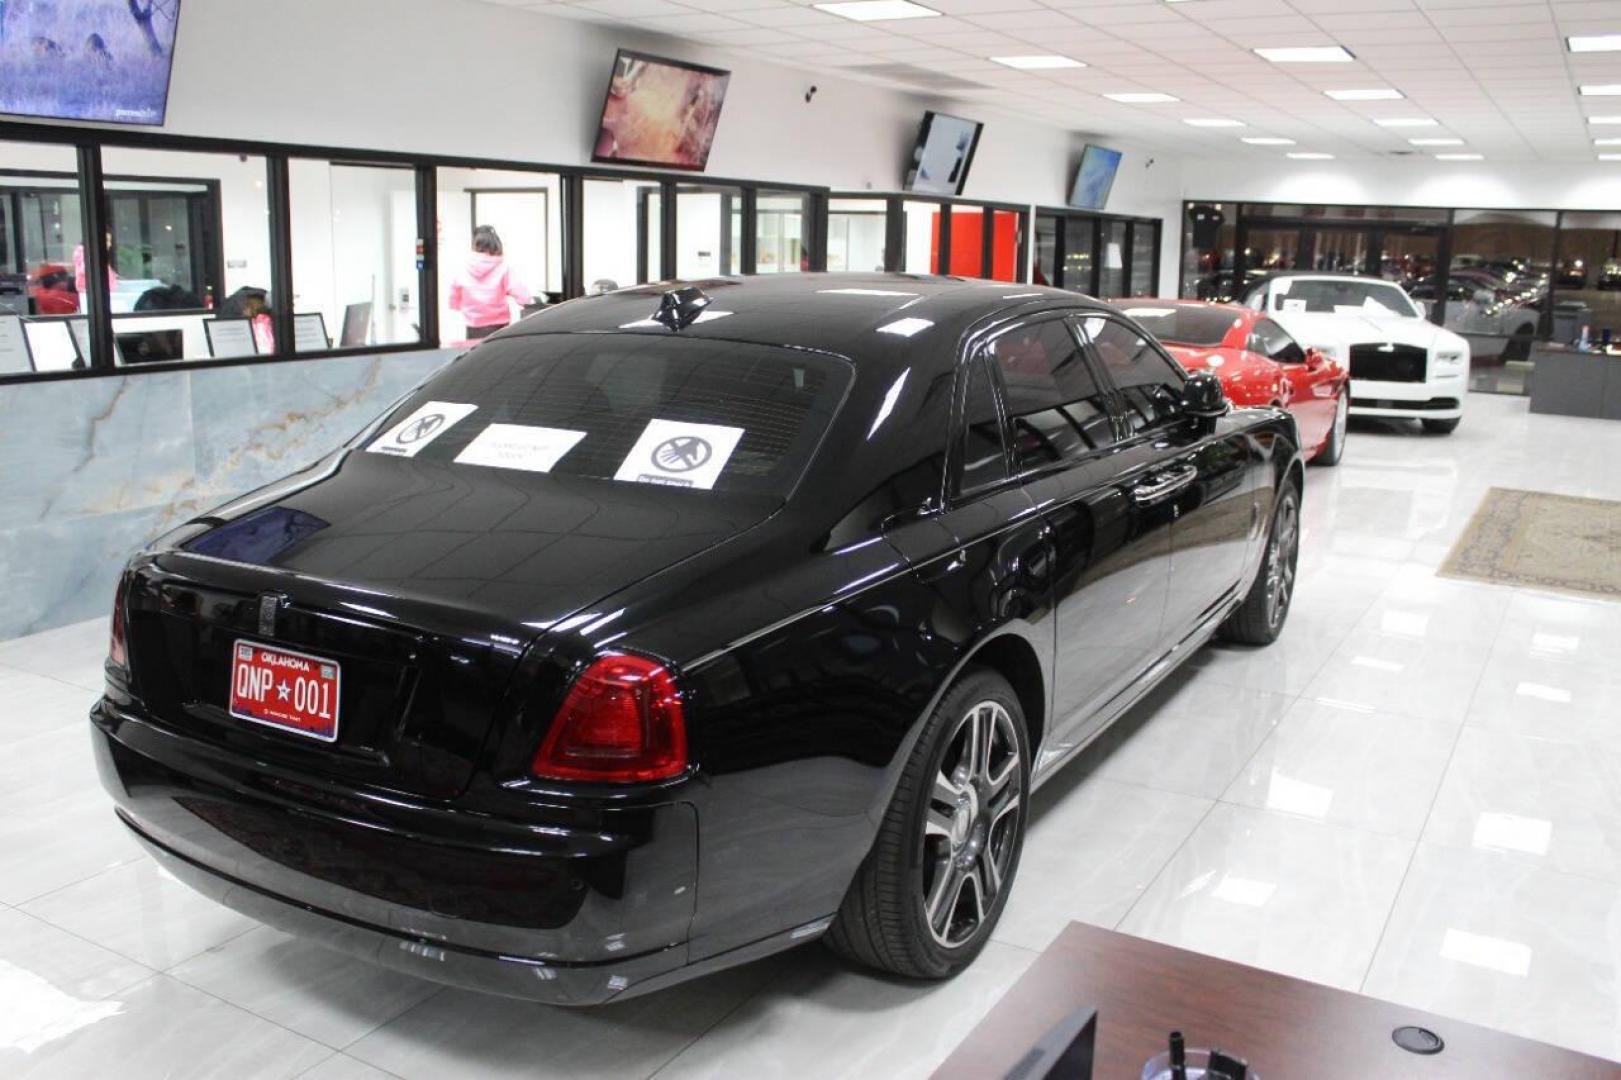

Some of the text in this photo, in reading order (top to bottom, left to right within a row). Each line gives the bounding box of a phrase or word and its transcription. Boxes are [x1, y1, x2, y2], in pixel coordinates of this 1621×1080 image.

[261, 652, 310, 672] OKLAHOMA
[237, 664, 331, 719] QNP 001
